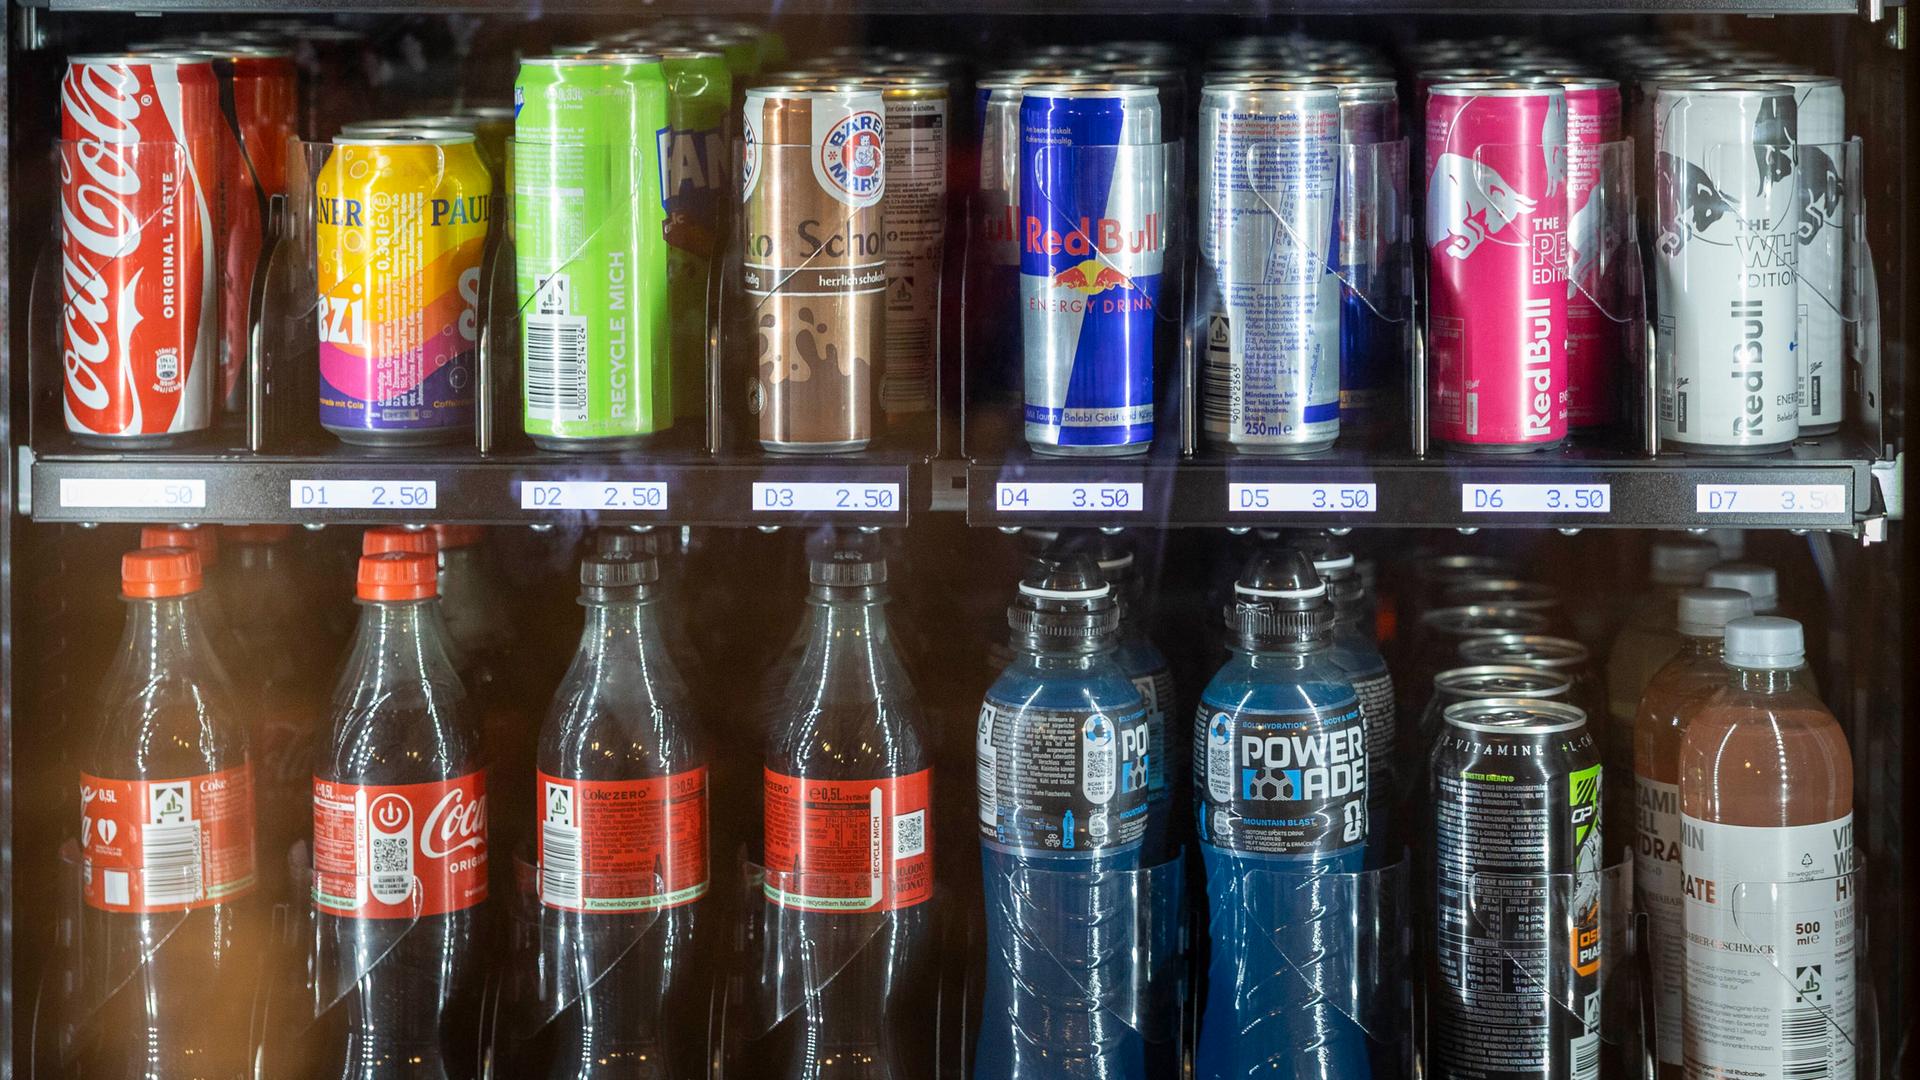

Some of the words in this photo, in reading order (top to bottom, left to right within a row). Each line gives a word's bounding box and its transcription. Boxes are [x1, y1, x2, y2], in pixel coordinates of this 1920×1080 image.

[163, 172, 174, 225] TASTE
[317, 197, 362, 226] NER
[1532, 216, 1559, 231] THE
[1736, 218, 1770, 231] THE
[1026, 216, 1090, 256] Red
[1097, 213, 1158, 254] Bull
[163, 233, 174, 319] ORIGINAL
[608, 251, 625, 309] MICH
[818, 275, 858, 287] herrlich
[1029, 296, 1094, 314] ENERGY
[1103, 296, 1152, 314] DRINK
[1523, 298, 1551, 365] Bull
[1731, 300, 1764, 364] Bull
[609, 327, 626, 420] RECYCLE
[1523, 368, 1551, 437] Red
[1731, 370, 1764, 437] Red
[1064, 412, 1093, 422] Belebt
[1095, 412, 1119, 422] Geist
[302, 486, 328, 505] D1
[372, 486, 429, 506] 2.50
[533, 487, 562, 506] D2
[604, 487, 661, 506] 2.50
[765, 488, 794, 507] D3
[836, 488, 893, 508] 2.50
[1001, 488, 1030, 507] D4
[1072, 488, 1130, 508] 3.50
[1241, 488, 1270, 508] D5
[1312, 488, 1370, 508] 3.50
[1475, 489, 1504, 508] D6
[1547, 489, 1604, 509] 3.50
[1709, 490, 1738, 509] D7
[1122, 722, 1150, 762] PO
[1241, 725, 1363, 767] POWER
[200, 779, 227, 793] Coke
[1303, 758, 1366, 801] ADE
[1243, 818, 1286, 826] MOUNTAIN
[1287, 817, 1316, 827] BLAST
[1795, 921, 1820, 935] 500
